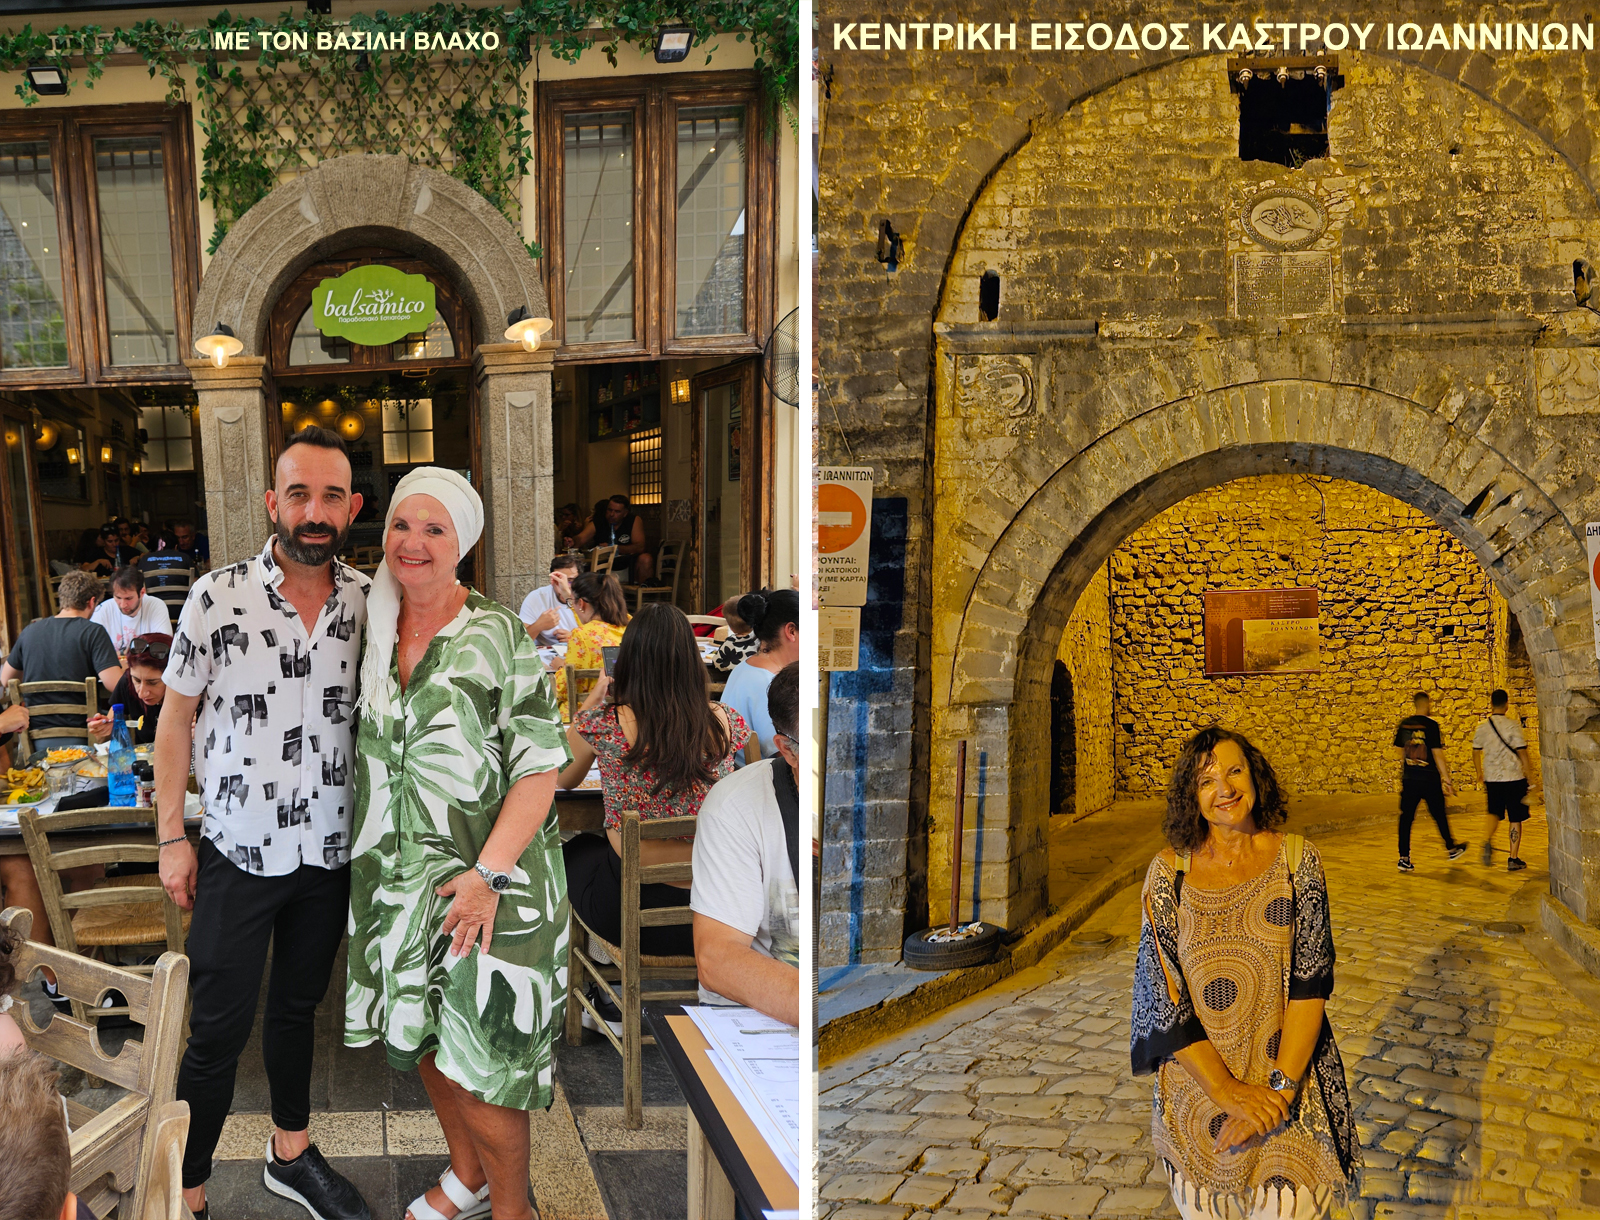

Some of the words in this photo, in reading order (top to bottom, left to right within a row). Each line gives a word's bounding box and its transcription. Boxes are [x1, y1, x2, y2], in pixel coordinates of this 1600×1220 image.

[323, 288, 425, 317] balsamico
[338, 315, 379, 323] Παραδοσιακό
[823, 470, 873, 481] ΙΩΑΝΝΙΤΩΝ
[1587, 526, 1600, 536] ΔΗ
